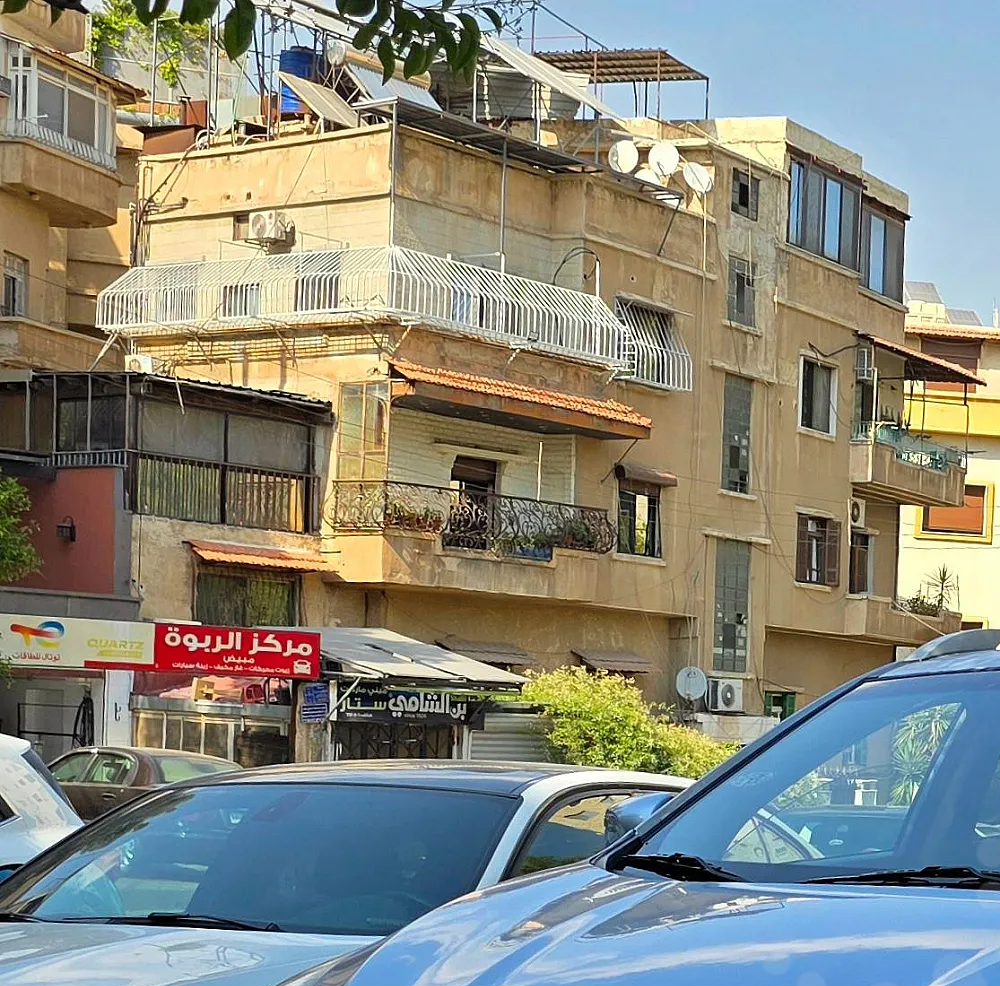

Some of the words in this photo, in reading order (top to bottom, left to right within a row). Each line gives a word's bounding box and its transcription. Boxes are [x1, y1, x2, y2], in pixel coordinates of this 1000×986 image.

[87, 638, 145, 649] QUARTZ
[164, 626, 242, 653] الربوة
[248, 632, 313, 656] مركز
[222, 655, 255, 665] مبيض
[339, 685, 367, 695] مارت
[339, 696, 387, 713] ستار
[388, 692, 450, 718] الشامي
[450, 701, 467, 720] بن
